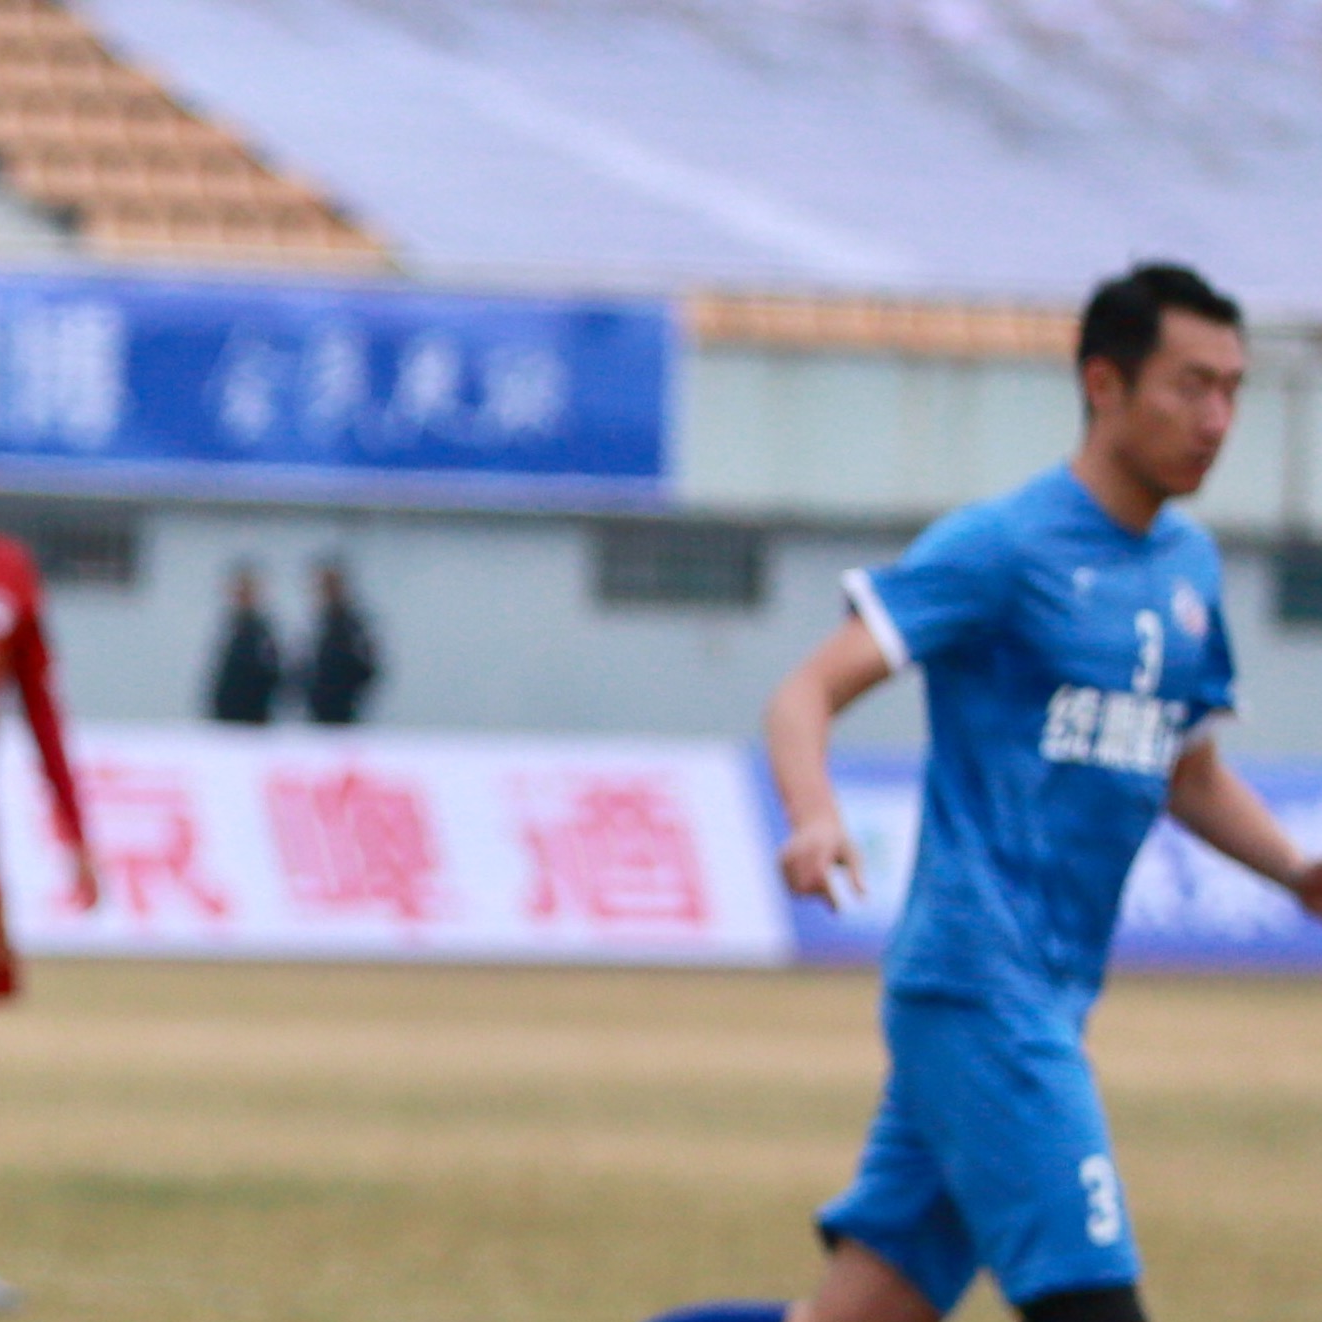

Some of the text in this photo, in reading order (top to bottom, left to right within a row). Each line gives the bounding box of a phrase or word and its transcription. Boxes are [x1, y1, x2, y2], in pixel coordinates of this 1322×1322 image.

[1131, 608, 1166, 697] 3
[45, 764, 707, 930] 京啤酒
[1078, 1152, 1122, 1247] 3
